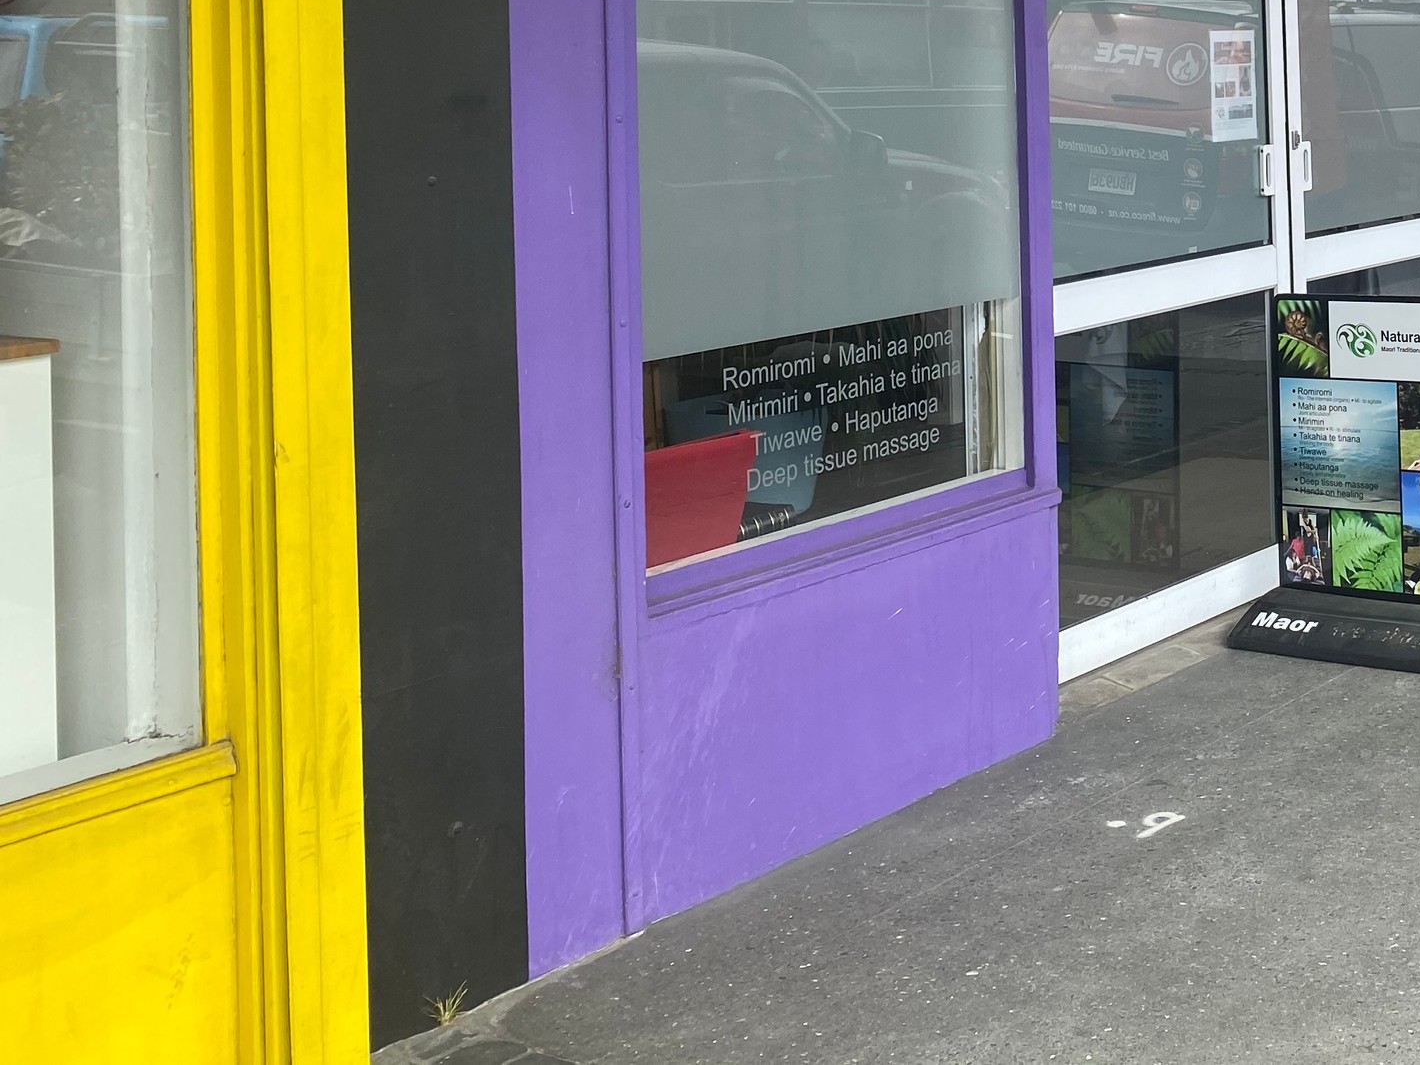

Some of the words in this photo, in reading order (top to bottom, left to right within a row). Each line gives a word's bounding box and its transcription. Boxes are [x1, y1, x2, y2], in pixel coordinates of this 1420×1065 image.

[722, 352, 816, 392] Romiromi
[838, 342, 881, 368] Mahi
[886, 338, 908, 359] aa
[913, 329, 954, 359] pona
[728, 390, 799, 427] Mirimiri
[815, 376, 885, 407] Takahia
[890, 369, 907, 389] te
[910, 358, 961, 384] tinana
[1298, 387, 1332, 396] Romiromi
[1298, 402, 1315, 410] Mahi
[1329, 405, 1347, 413] pona
[750, 422, 822, 456] Tiwawe
[845, 395, 939, 434] Haputanga
[1299, 432, 1327, 441] Takahia
[1300, 447, 1327, 455] Tiwawe
[746, 462, 798, 493] Deep
[803, 449, 857, 478] tissue
[863, 426, 940, 461] massage
[1300, 462, 1339, 473] Haputanga
[1300, 477, 1319, 486] Deep
[1321, 479, 1342, 487] tissue
[1345, 481, 1378, 491] massage
[1301, 487, 1323, 495] Hands
[1337, 490, 1363, 500] healing
